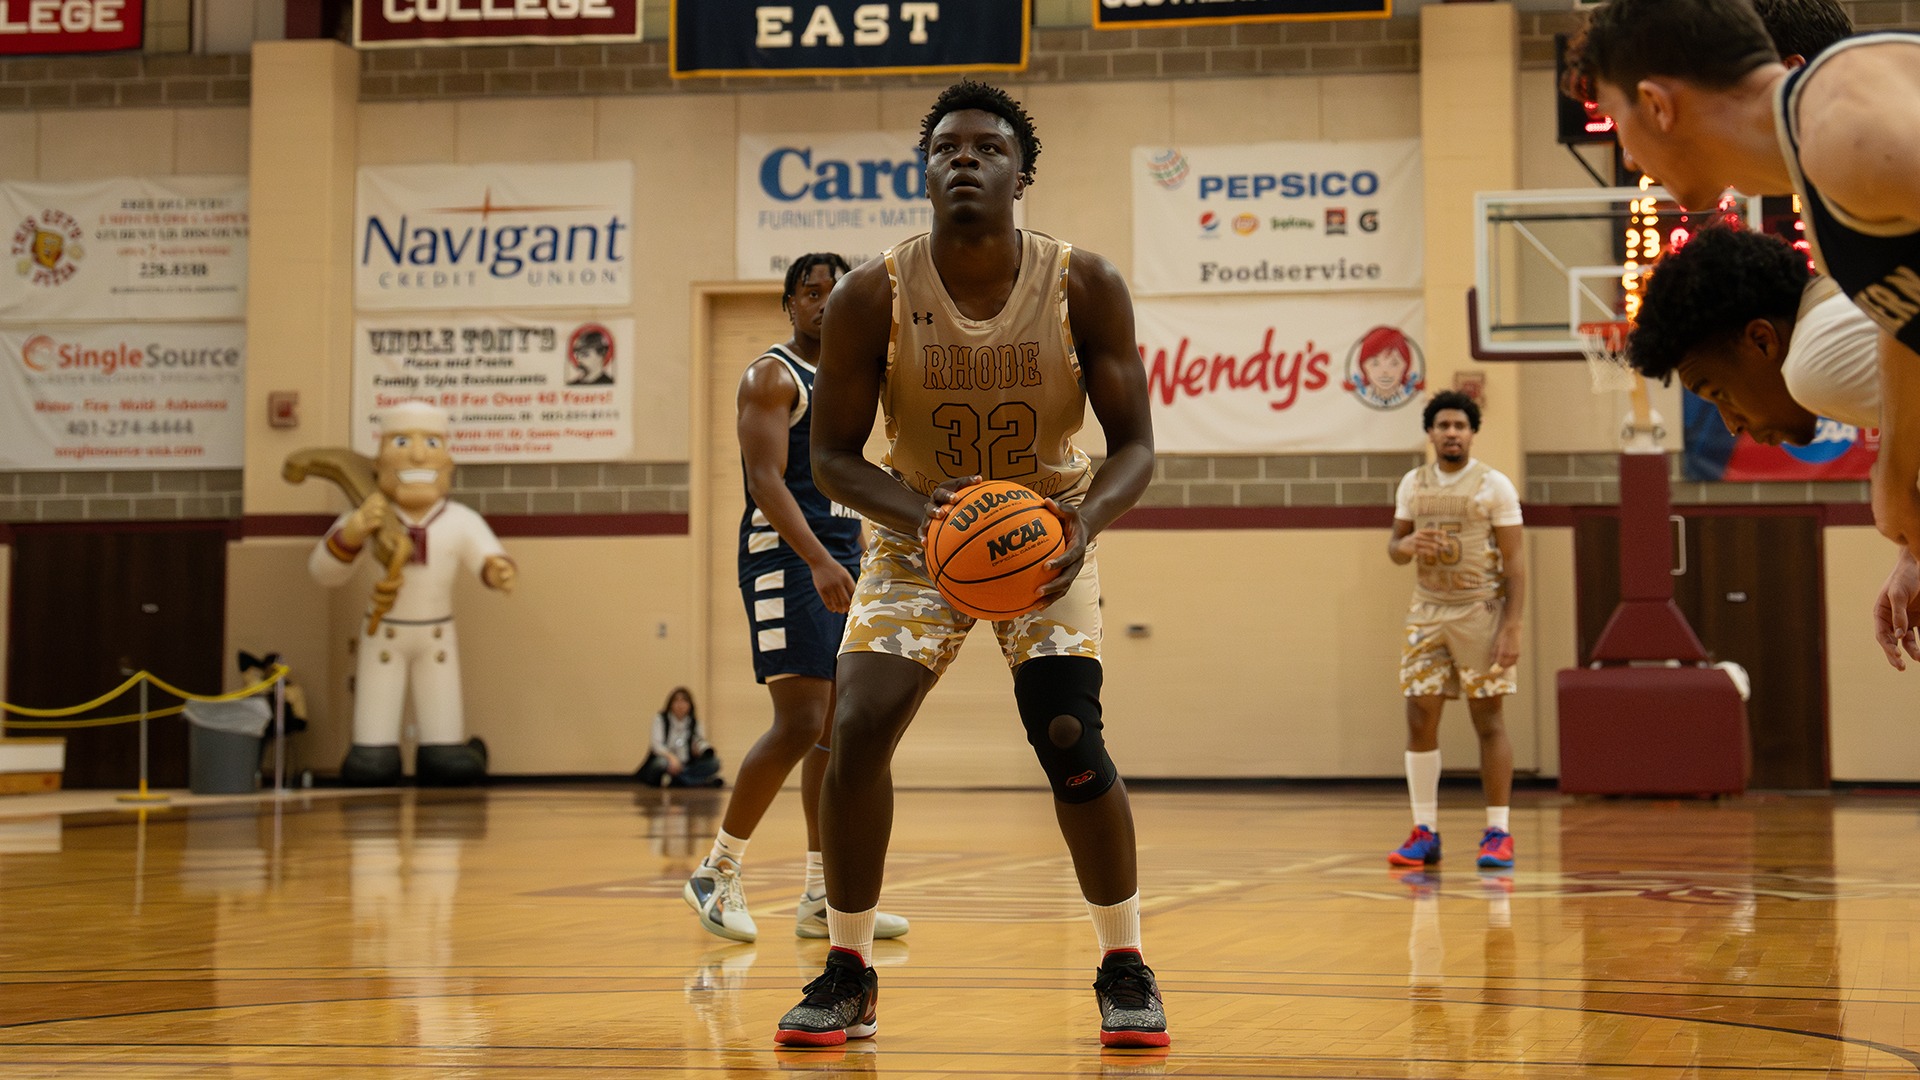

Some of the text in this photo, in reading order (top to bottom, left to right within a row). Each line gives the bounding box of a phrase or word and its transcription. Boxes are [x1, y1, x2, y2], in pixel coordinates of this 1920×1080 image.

[755, 3, 939, 48] EAST
[1199, 170, 1379, 200] PEPSICO
[759, 207, 934, 230] FURNITURE MATT
[362, 214, 626, 279] Navigant
[378, 268, 617, 289] CREDIT UNION
[1200, 258, 1381, 283] Foodservice
[58, 342, 240, 375] SingleSource
[368, 327, 556, 353] UNCLE TONY'S
[923, 342, 1042, 390] RHODE
[1138, 327, 1330, 411] Wendy's
[932, 401, 1037, 480] 32
[948, 490, 1037, 533] Wilson
[986, 517, 1048, 562] NCAA
[991, 552, 1020, 568] OFFICIAL
